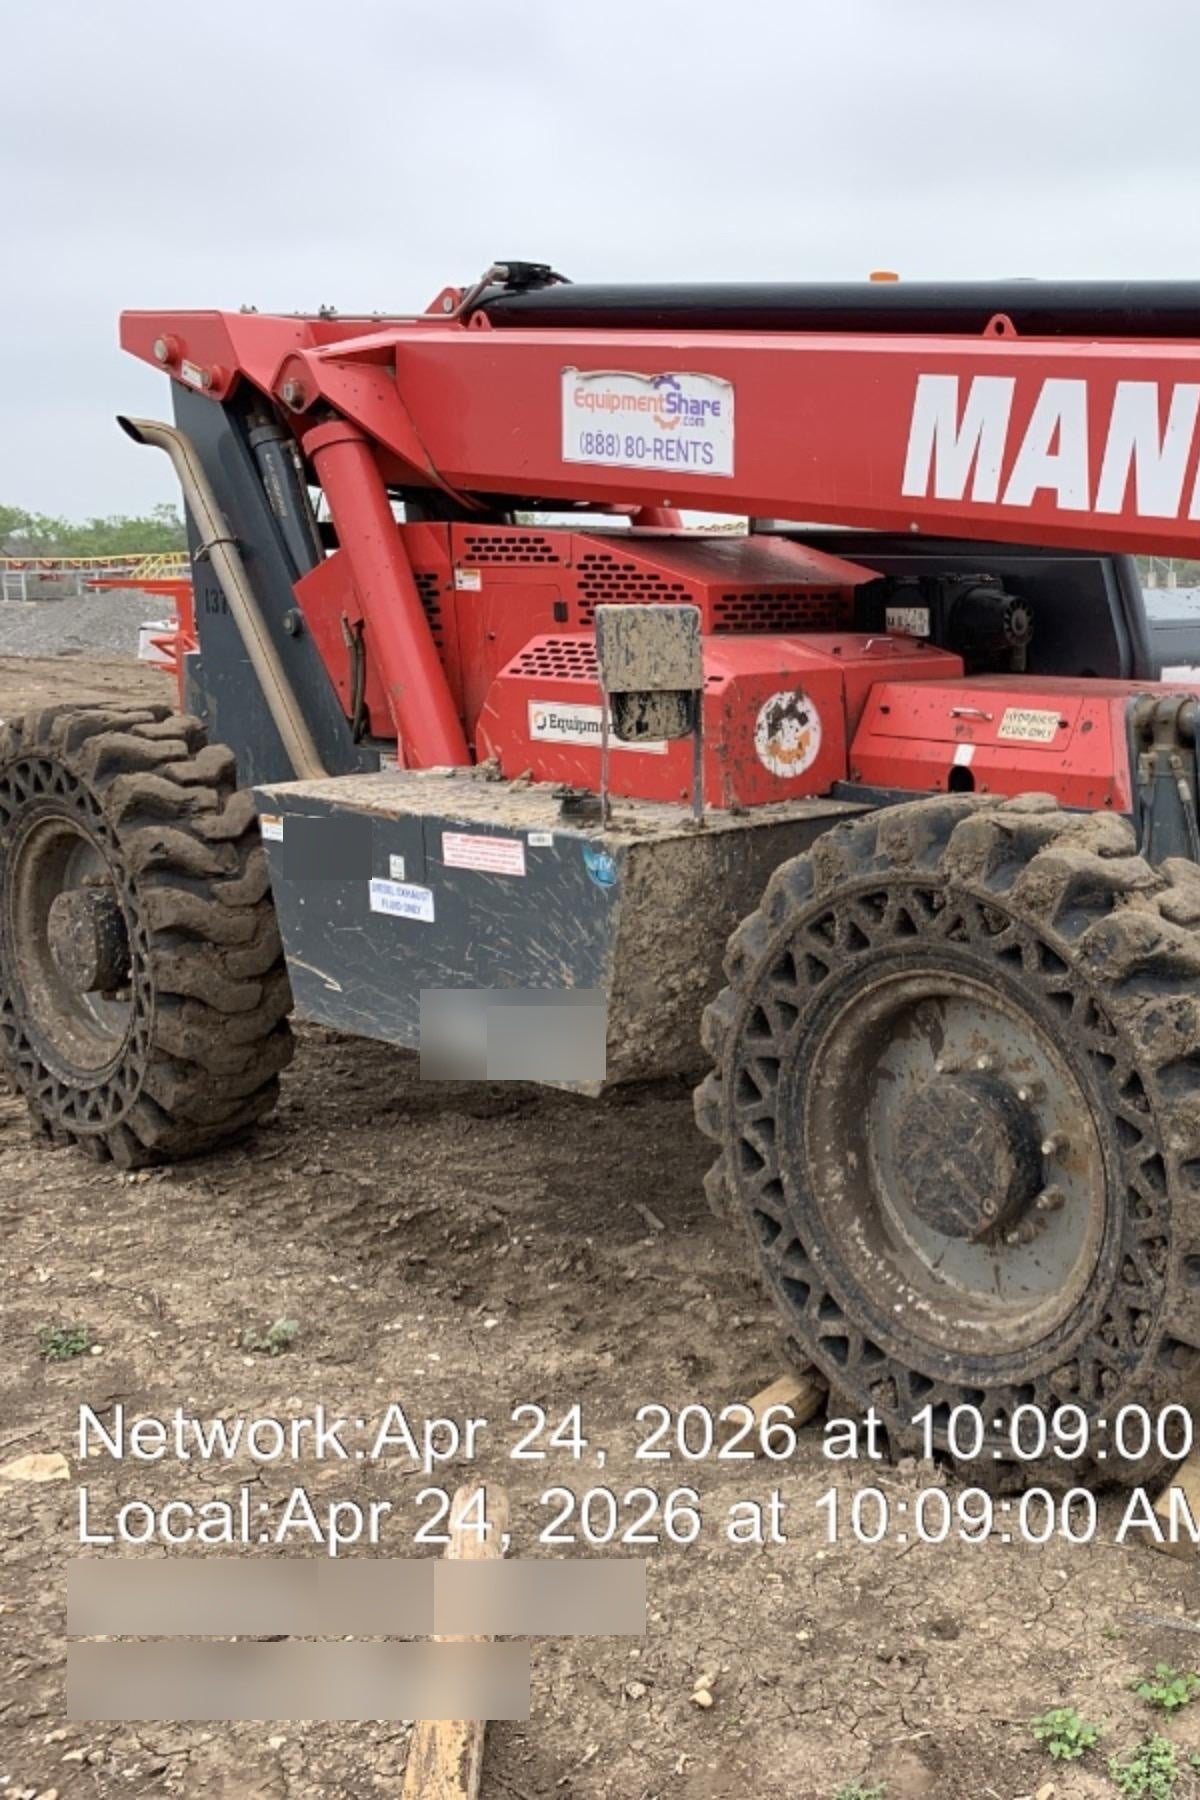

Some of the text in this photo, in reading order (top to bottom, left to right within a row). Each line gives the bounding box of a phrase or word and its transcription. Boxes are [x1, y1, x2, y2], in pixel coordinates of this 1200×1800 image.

[573, 388, 721, 417] EquipmentShare
[579, 431, 714, 465] (888) 80-RENTS
